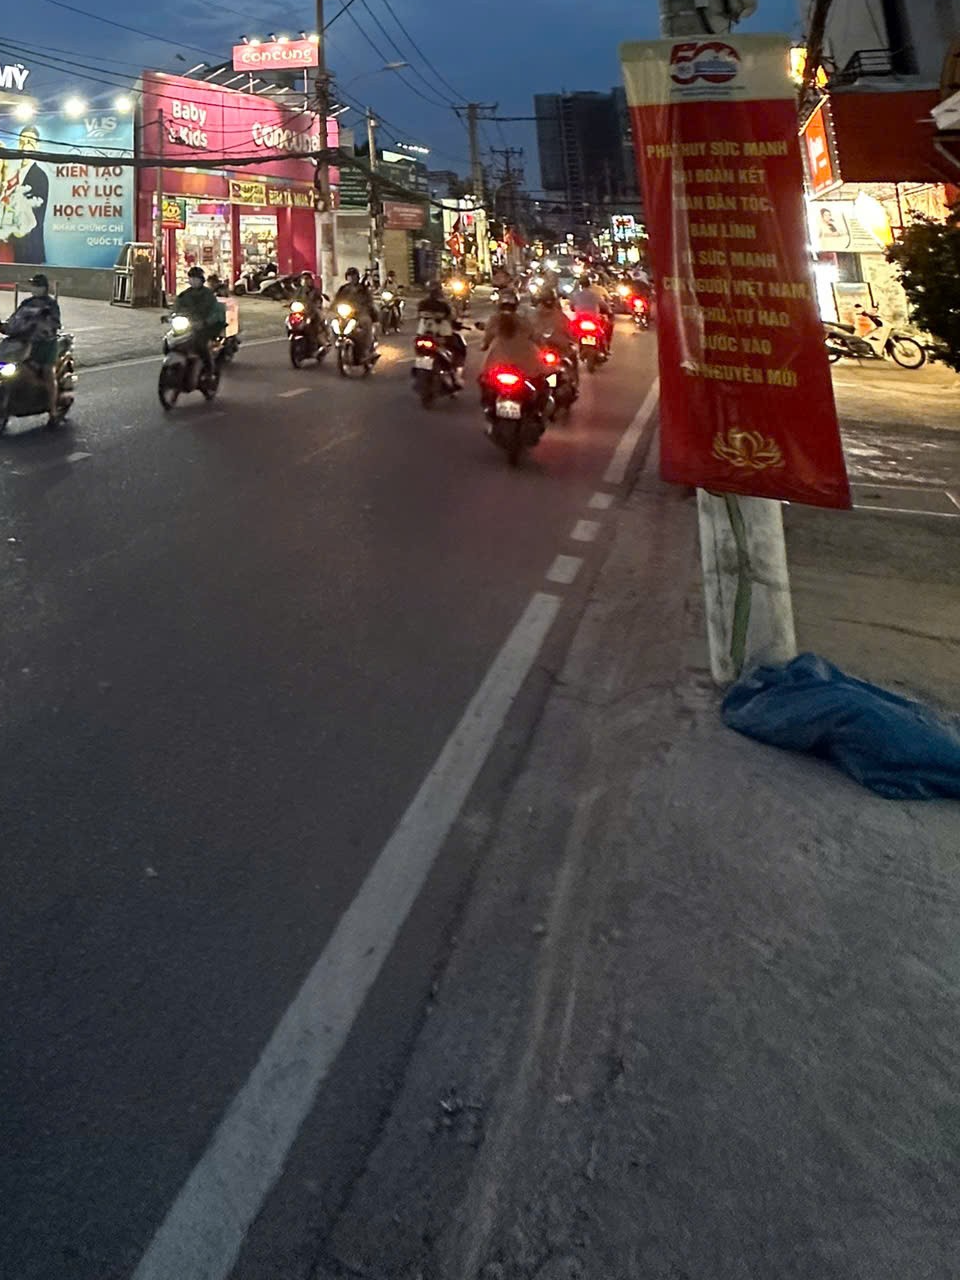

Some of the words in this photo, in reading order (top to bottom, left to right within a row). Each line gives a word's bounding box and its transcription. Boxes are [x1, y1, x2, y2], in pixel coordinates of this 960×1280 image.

[172, 100, 207, 127] Baby
[180, 126, 208, 149] Kids
[53, 204, 84, 221] HỌC
